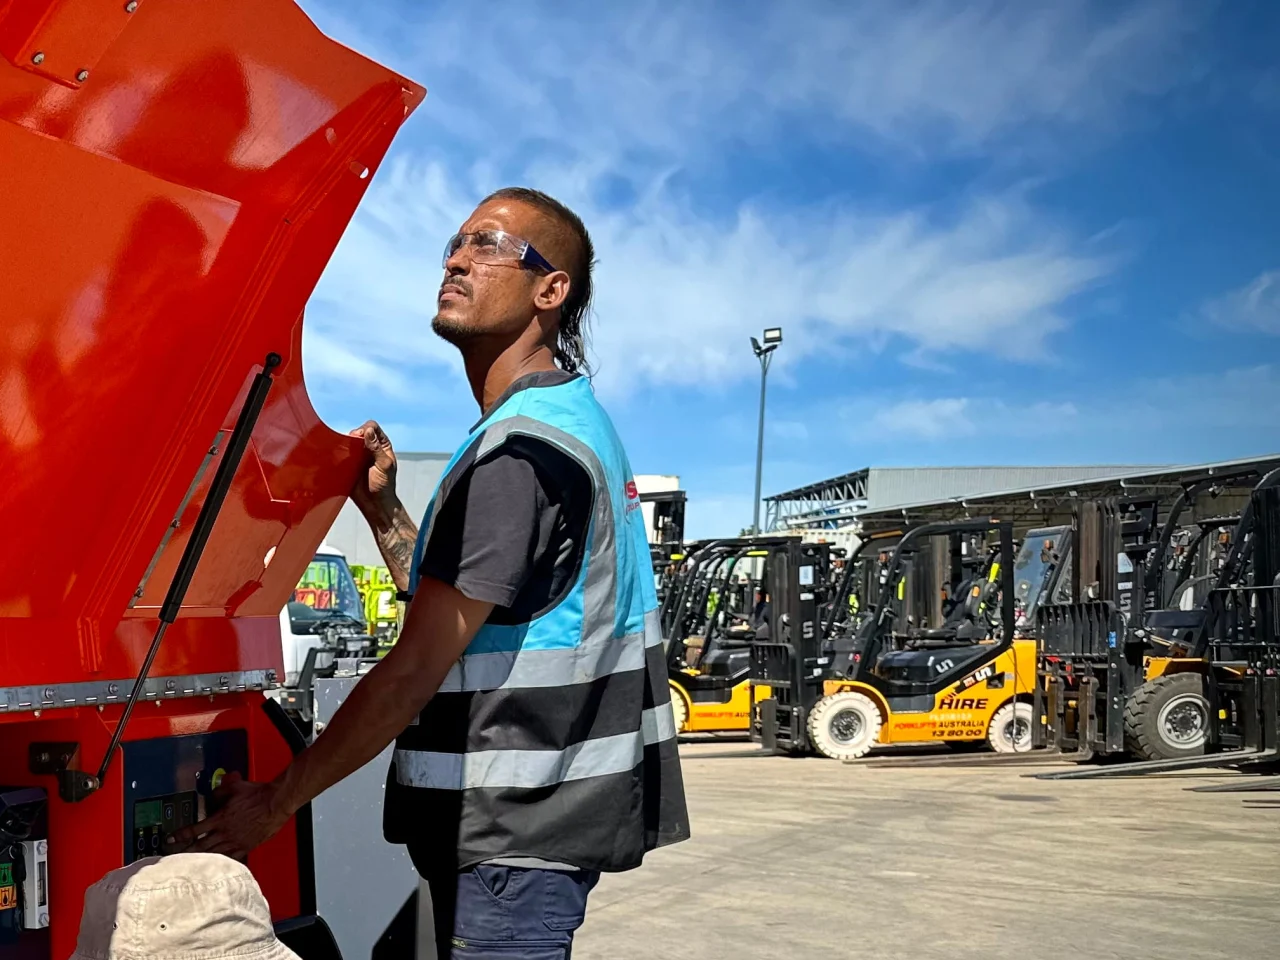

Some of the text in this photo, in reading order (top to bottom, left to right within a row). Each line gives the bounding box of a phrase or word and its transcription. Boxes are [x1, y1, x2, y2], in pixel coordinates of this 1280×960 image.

[938, 698, 988, 710] HIRE
[893, 720, 985, 730] FORKLIFTS AUSTRALIA
[947, 729, 964, 737] 80
